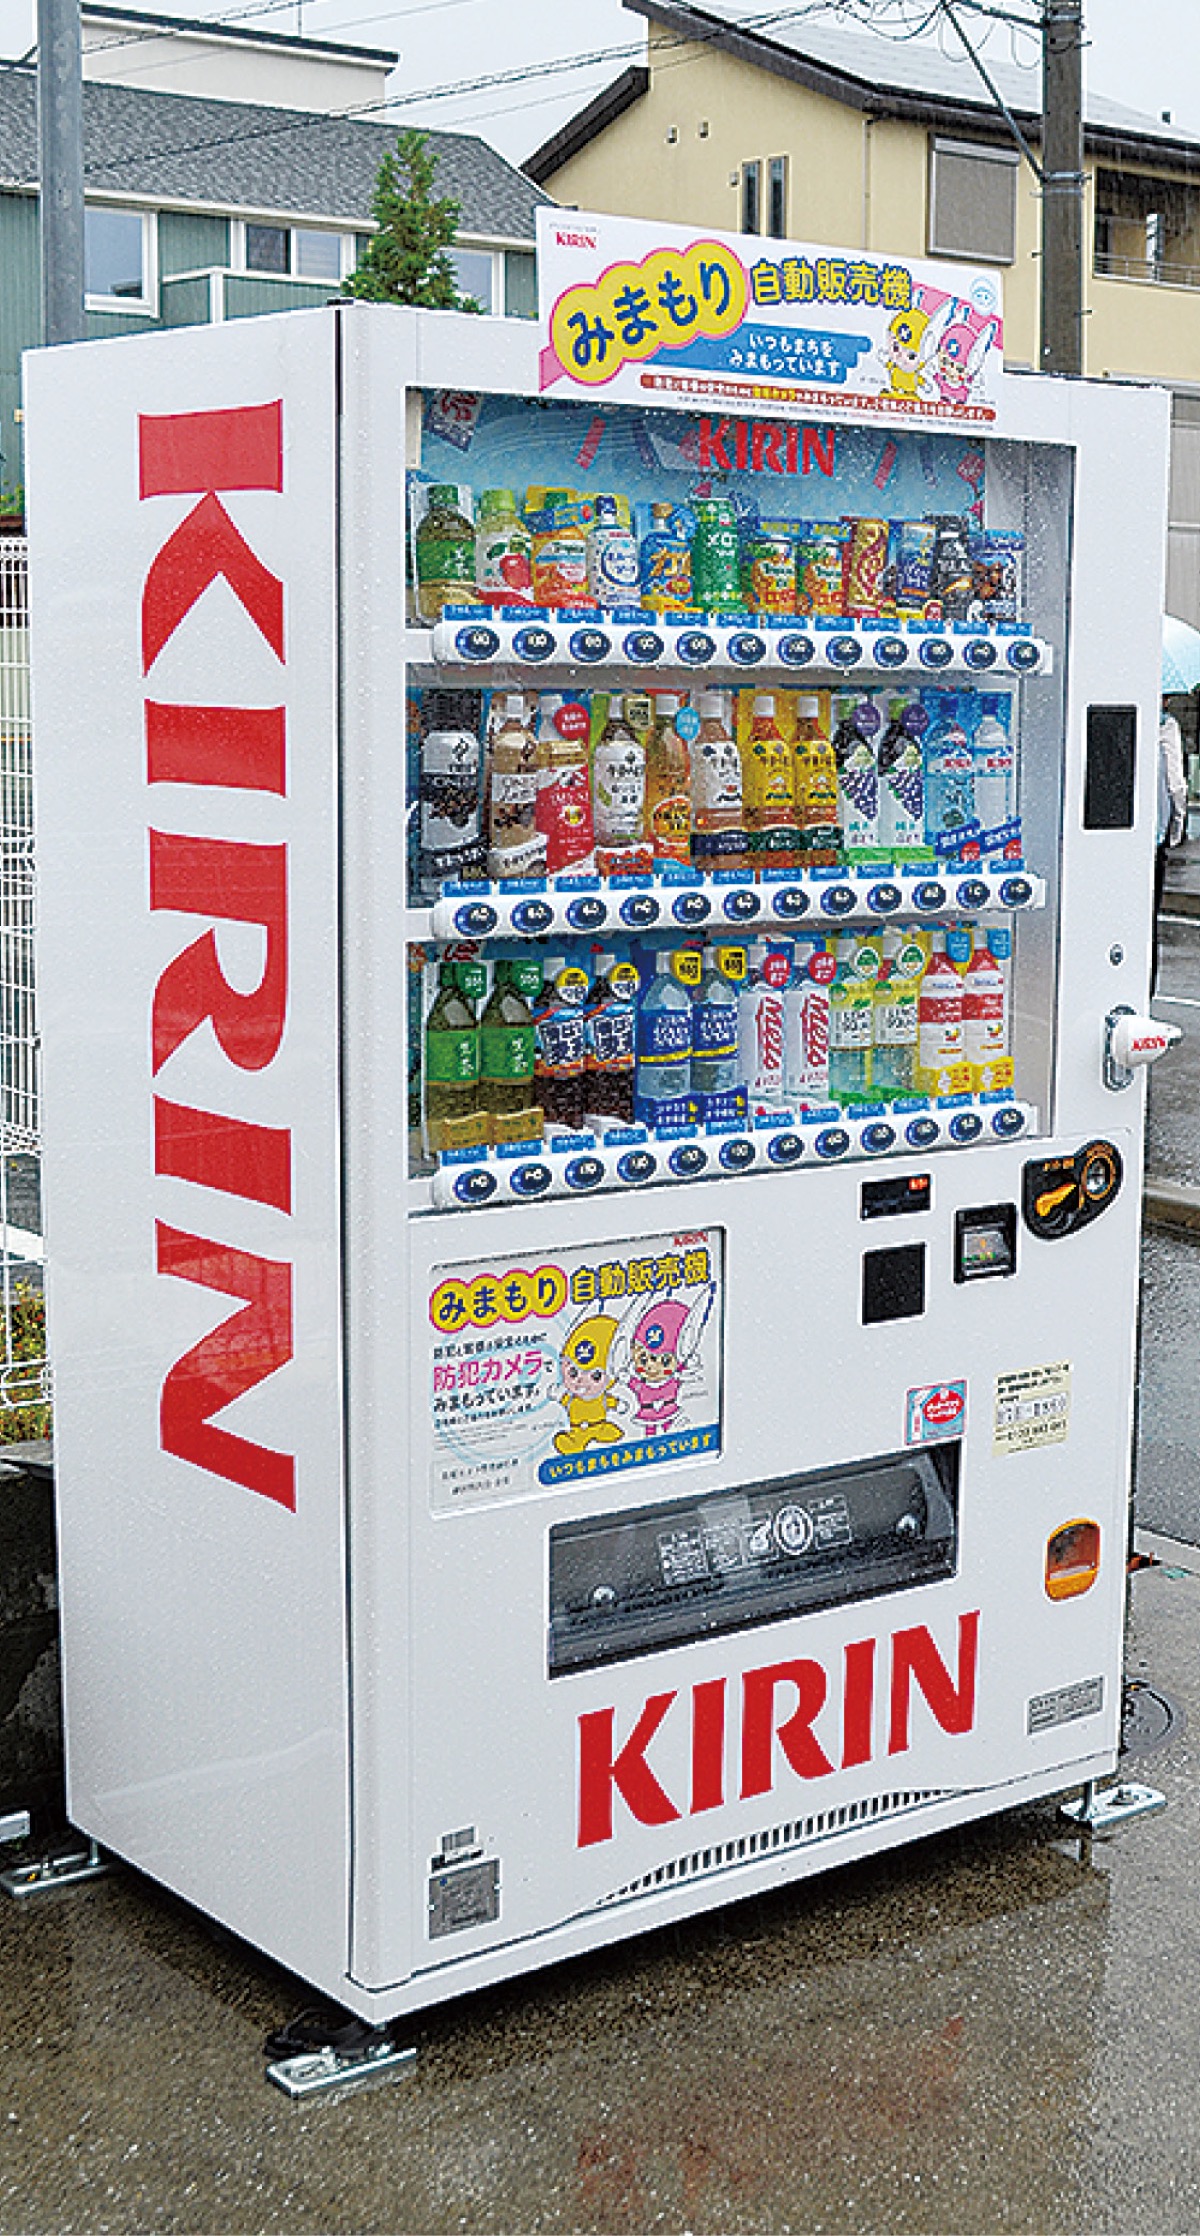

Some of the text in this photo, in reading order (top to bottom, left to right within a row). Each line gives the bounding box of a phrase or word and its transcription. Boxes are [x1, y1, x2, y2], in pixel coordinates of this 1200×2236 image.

[750, 257, 913, 310] 自動販売機
[567, 262, 730, 367] みまもり
[729, 351, 841, 377] みまもっています
[748, 333, 833, 356] いつもまちを
[699, 416, 836, 478] KIRIN
[139, 399, 297, 1512] KIRIN
[439, 1277, 558, 1323] みまもり
[570, 1248, 711, 1304] 自動販売機
[578, 1610, 981, 1849] KIRIN
